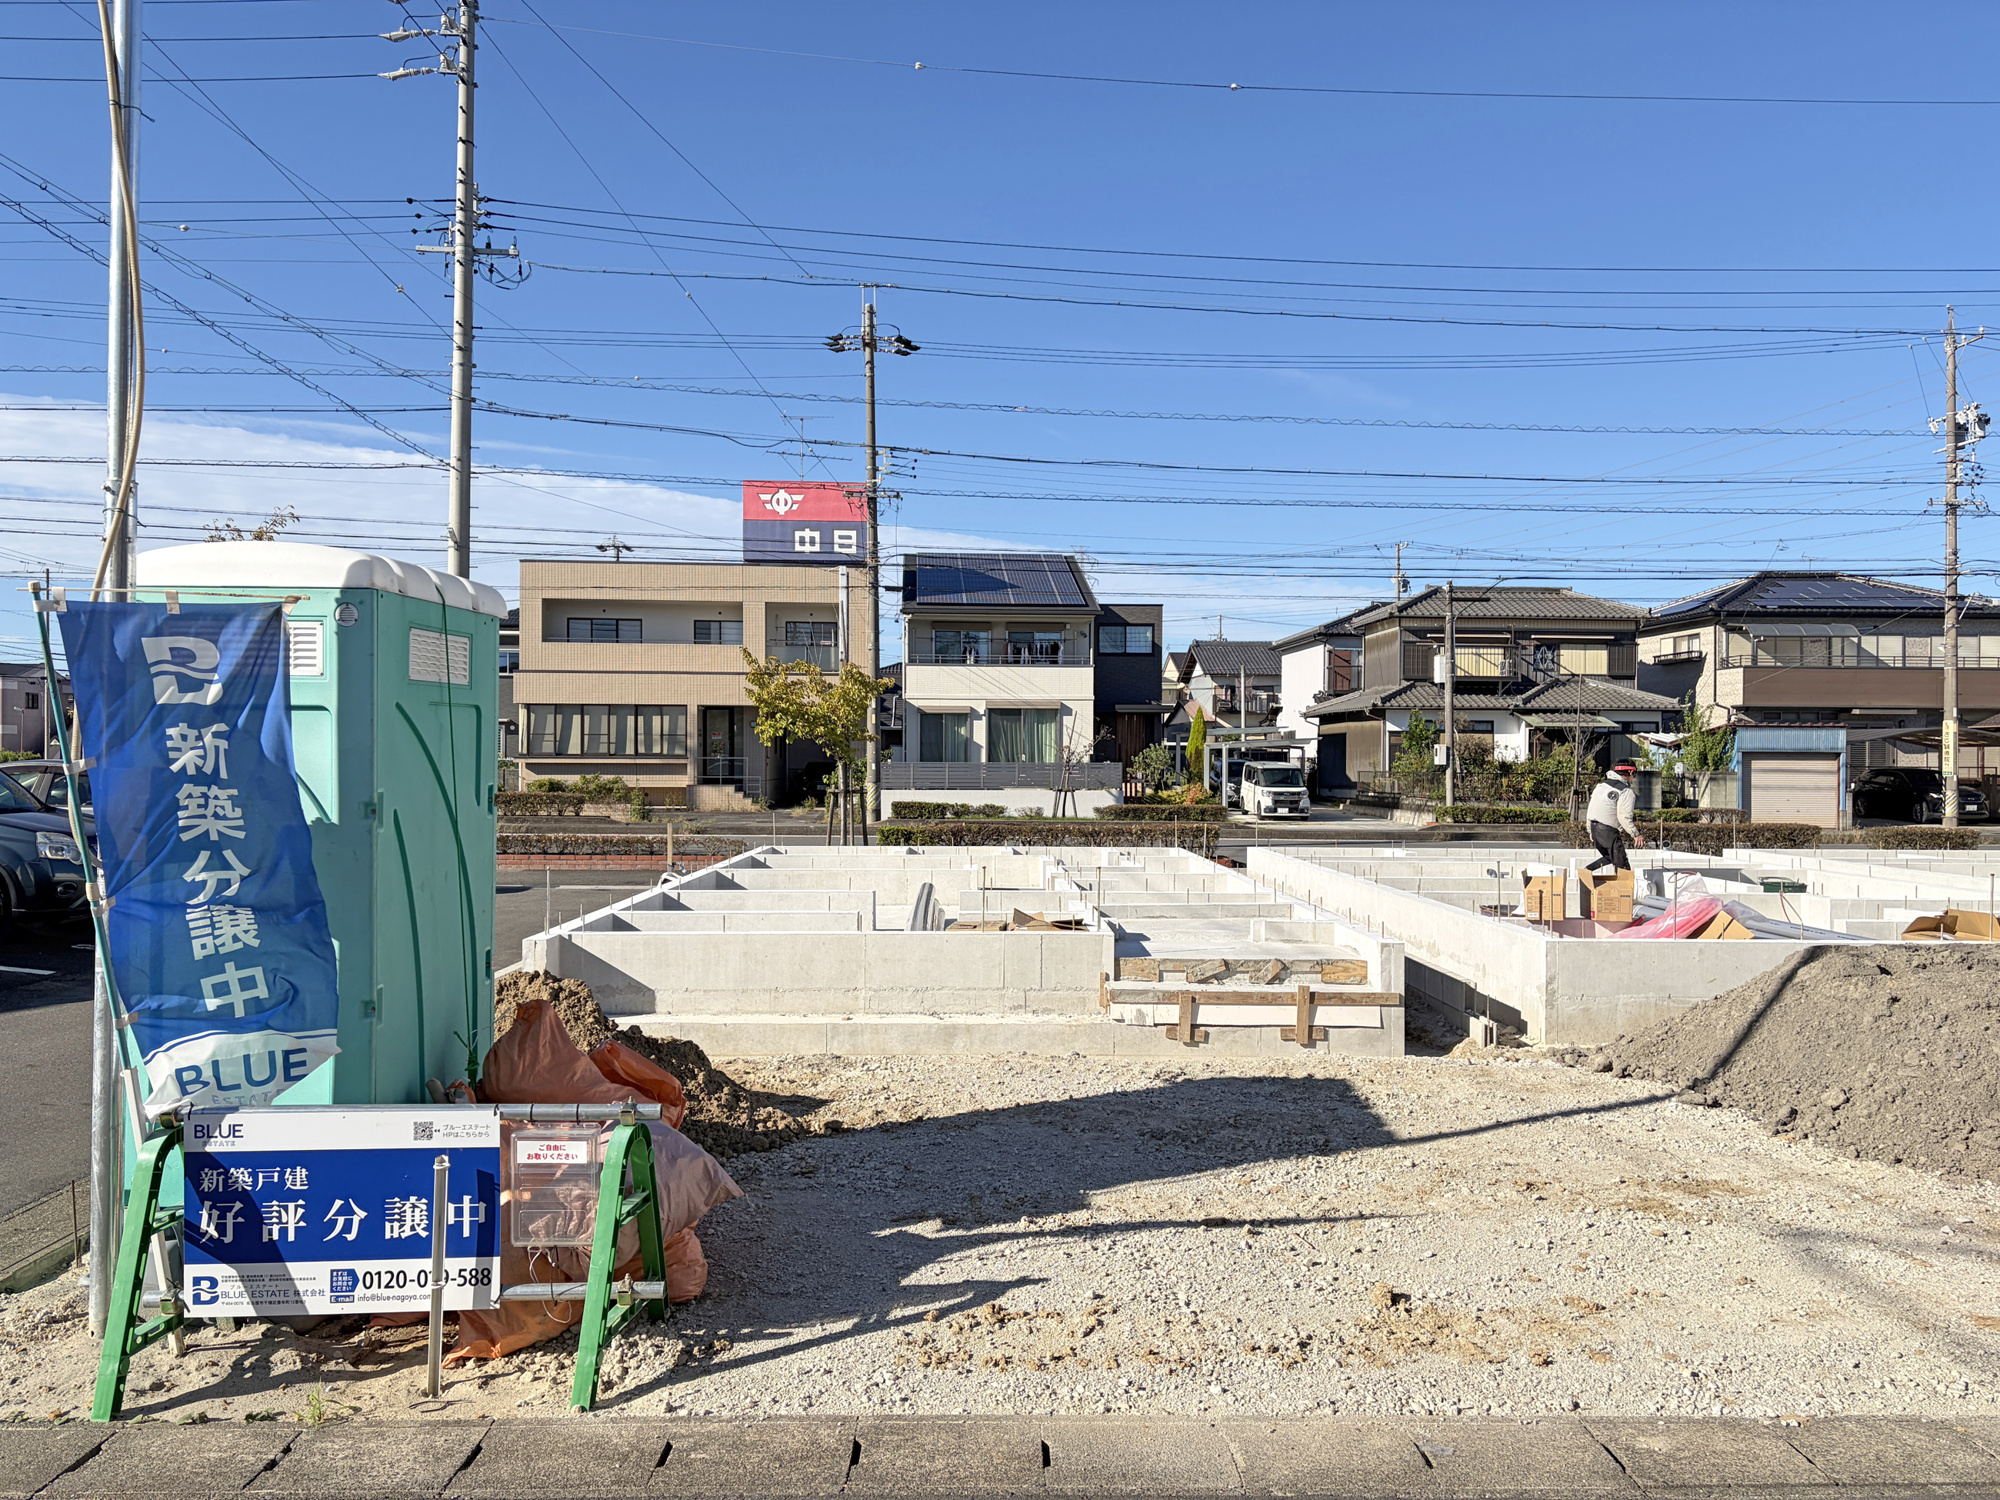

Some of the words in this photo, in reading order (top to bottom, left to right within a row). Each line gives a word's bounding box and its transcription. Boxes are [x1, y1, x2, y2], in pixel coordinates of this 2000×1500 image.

[794, 528, 857, 553] 中日
[165, 722, 270, 1018] 新築分譲中
[174, 1047, 309, 1098] BLUE
[211, 1088, 286, 1105] ESTAT
[194, 1123, 244, 1139] BLUE
[199, 1166, 309, 1192] 新築戸建
[199, 1195, 487, 1244] 好評分譲中
[361, 1267, 492, 1290] 0120-0-588
[220, 1290, 247, 1299] BLUE
[251, 1289, 290, 1299] ESTATE
[293, 1288, 327, 1298] 株式会社
